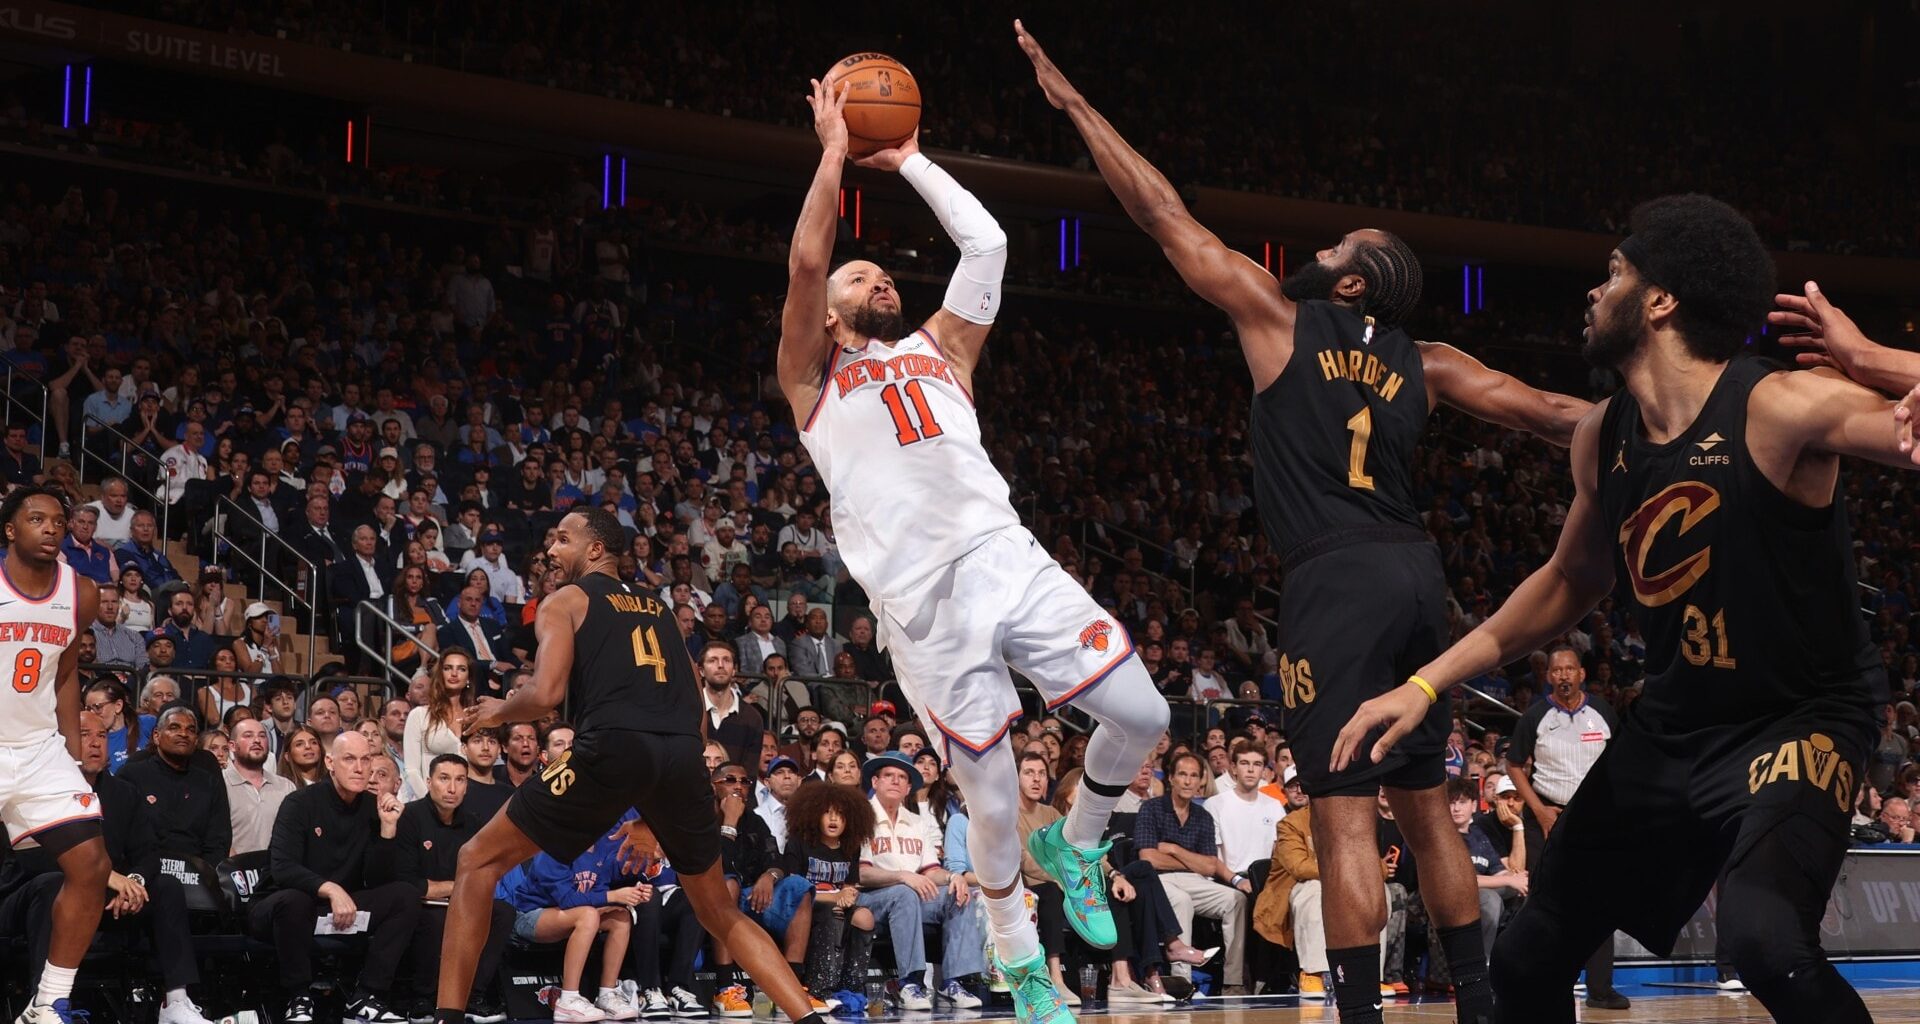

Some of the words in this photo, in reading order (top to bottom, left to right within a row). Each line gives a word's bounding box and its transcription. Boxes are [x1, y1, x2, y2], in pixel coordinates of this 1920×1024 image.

[126, 30, 200, 63] SUITE
[210, 44, 285, 77] LEVEL
[834, 358, 886, 400] NEW
[886, 353, 953, 386] YORK
[1317, 349, 1404, 402] HARDEN
[880, 379, 944, 447] 11
[1347, 405, 1376, 491] 1
[1689, 455, 1730, 467] CLIFFS
[1619, 480, 1721, 608] C
[605, 594, 664, 618] MOBLEY
[0, 622, 30, 642] EW
[31, 622, 72, 648] YORK
[631, 625, 668, 683] 4
[1680, 604, 1736, 669] 31
[12, 648, 43, 693] 8
[1748, 733, 1853, 813] CAVS
[160, 858, 185, 873] STERN
[870, 837, 892, 856] NEW
[896, 837, 923, 856] YOR
[1862, 881, 1901, 923] UP
